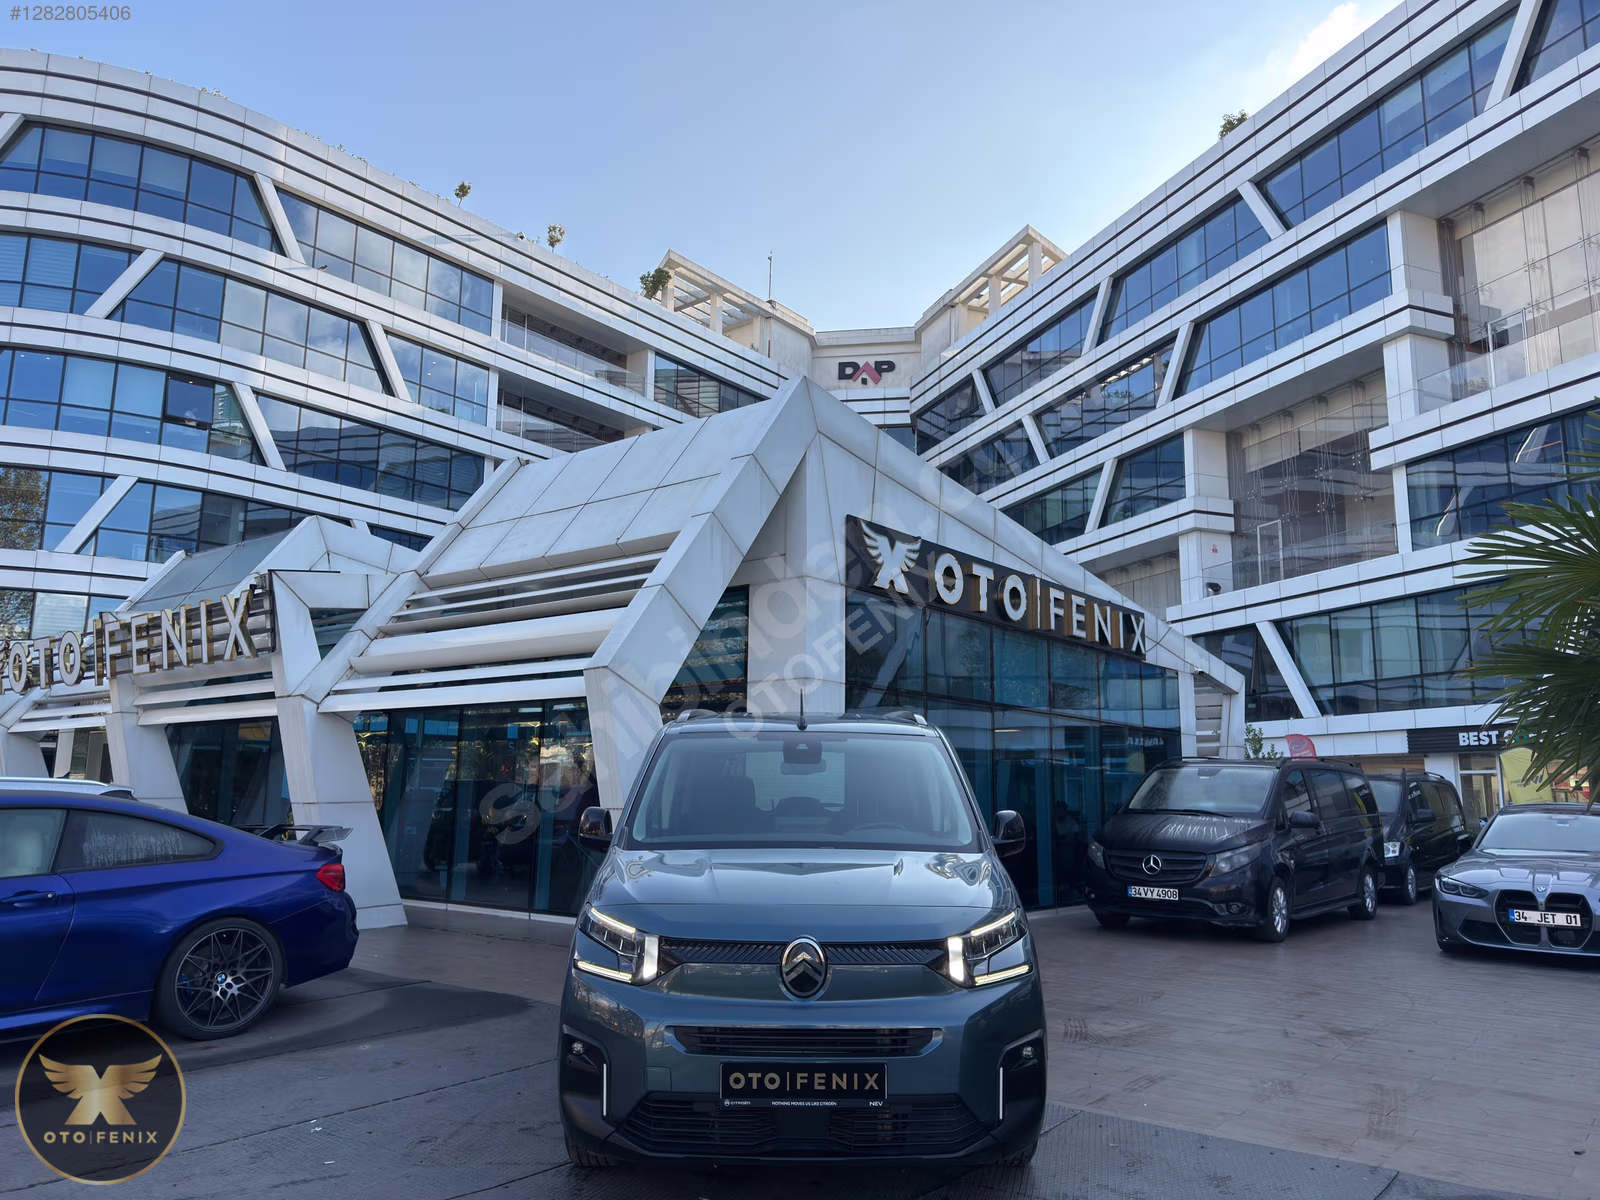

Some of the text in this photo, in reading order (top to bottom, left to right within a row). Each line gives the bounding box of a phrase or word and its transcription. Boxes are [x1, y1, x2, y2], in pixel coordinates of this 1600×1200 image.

[1458, 730, 1499, 746] BEST
[1132, 887, 1178, 899] 34 VY 4908
[1515, 911, 1528, 921] 34
[1537, 913, 1557, 924] JET
[1566, 915, 1578, 925] 01
